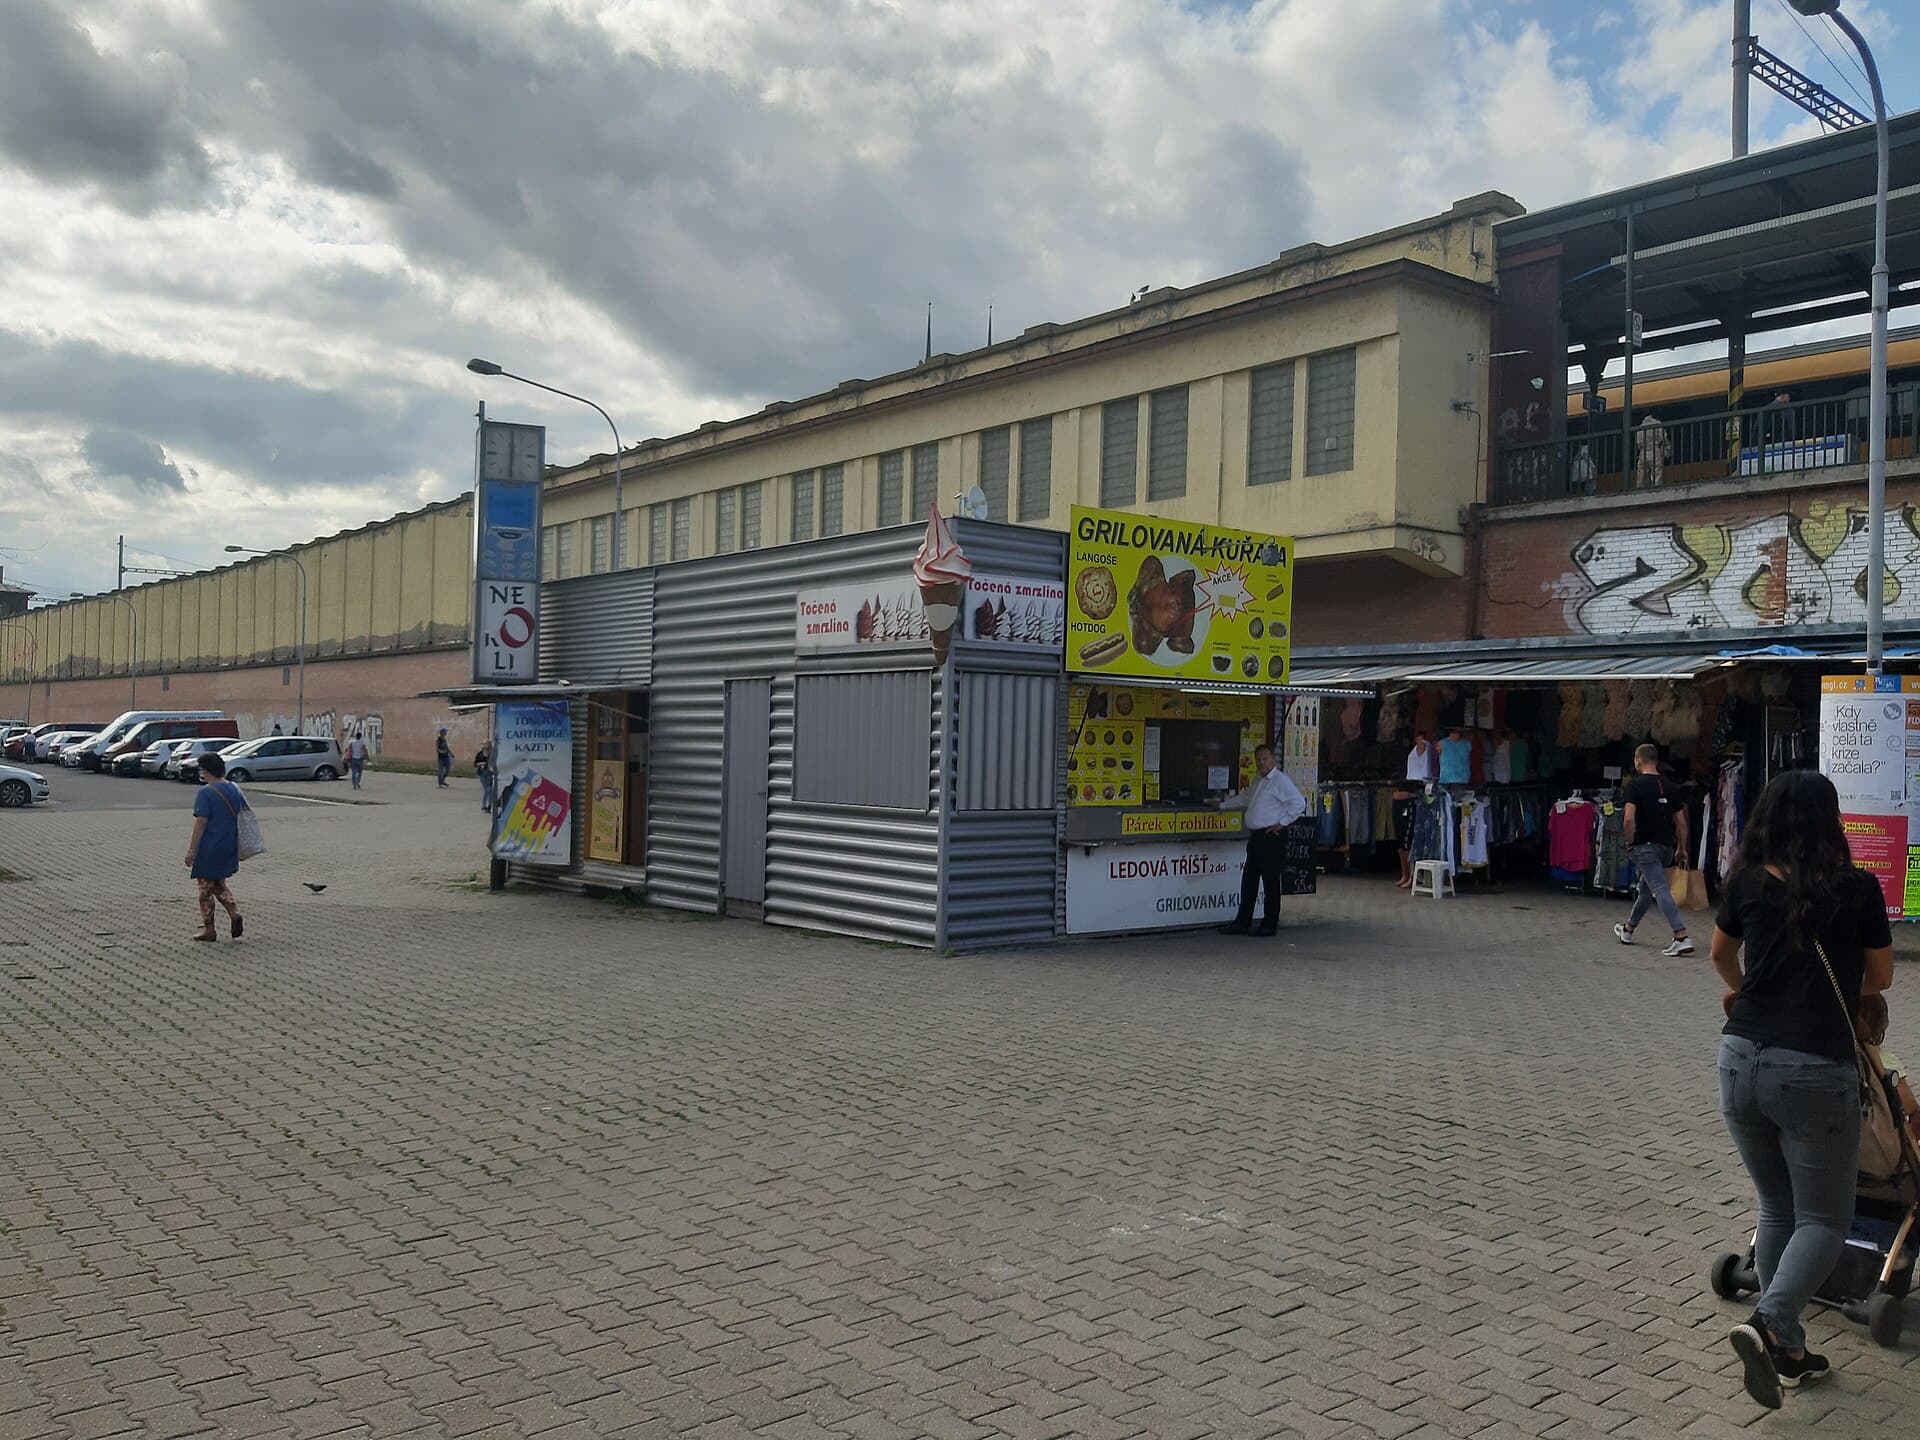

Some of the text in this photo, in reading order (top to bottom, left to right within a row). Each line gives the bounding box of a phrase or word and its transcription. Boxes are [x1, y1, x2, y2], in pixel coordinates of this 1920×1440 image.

[1077, 517, 1287, 568] GRILOVANÁ KUŘAA
[1076, 552, 1117, 566] LANGOŠE
[1212, 573, 1232, 586] AKCE
[489, 585, 525, 604] NE
[968, 578, 1064, 600] Točená zmrzlina
[800, 599, 837, 616] Točená
[806, 618, 849, 635] zmrzlina
[1070, 622, 1106, 634] HOTDOG
[1832, 719, 1878, 732] vlastně
[506, 730, 565, 739] CARTRIDGE
[1832, 732, 1873, 746] celá ta
[514, 743, 556, 752] KAZETY
[1831, 747, 1860, 759] krize
[1126, 815, 1227, 832] Párek v rohlíku
[1110, 856, 1168, 879] LEDOVÁ
[1171, 853, 1209, 876] TŘÍŠŤ
[1209, 863, 1215, 873] 2
[1156, 892, 1226, 912] GRILOVANÁ
